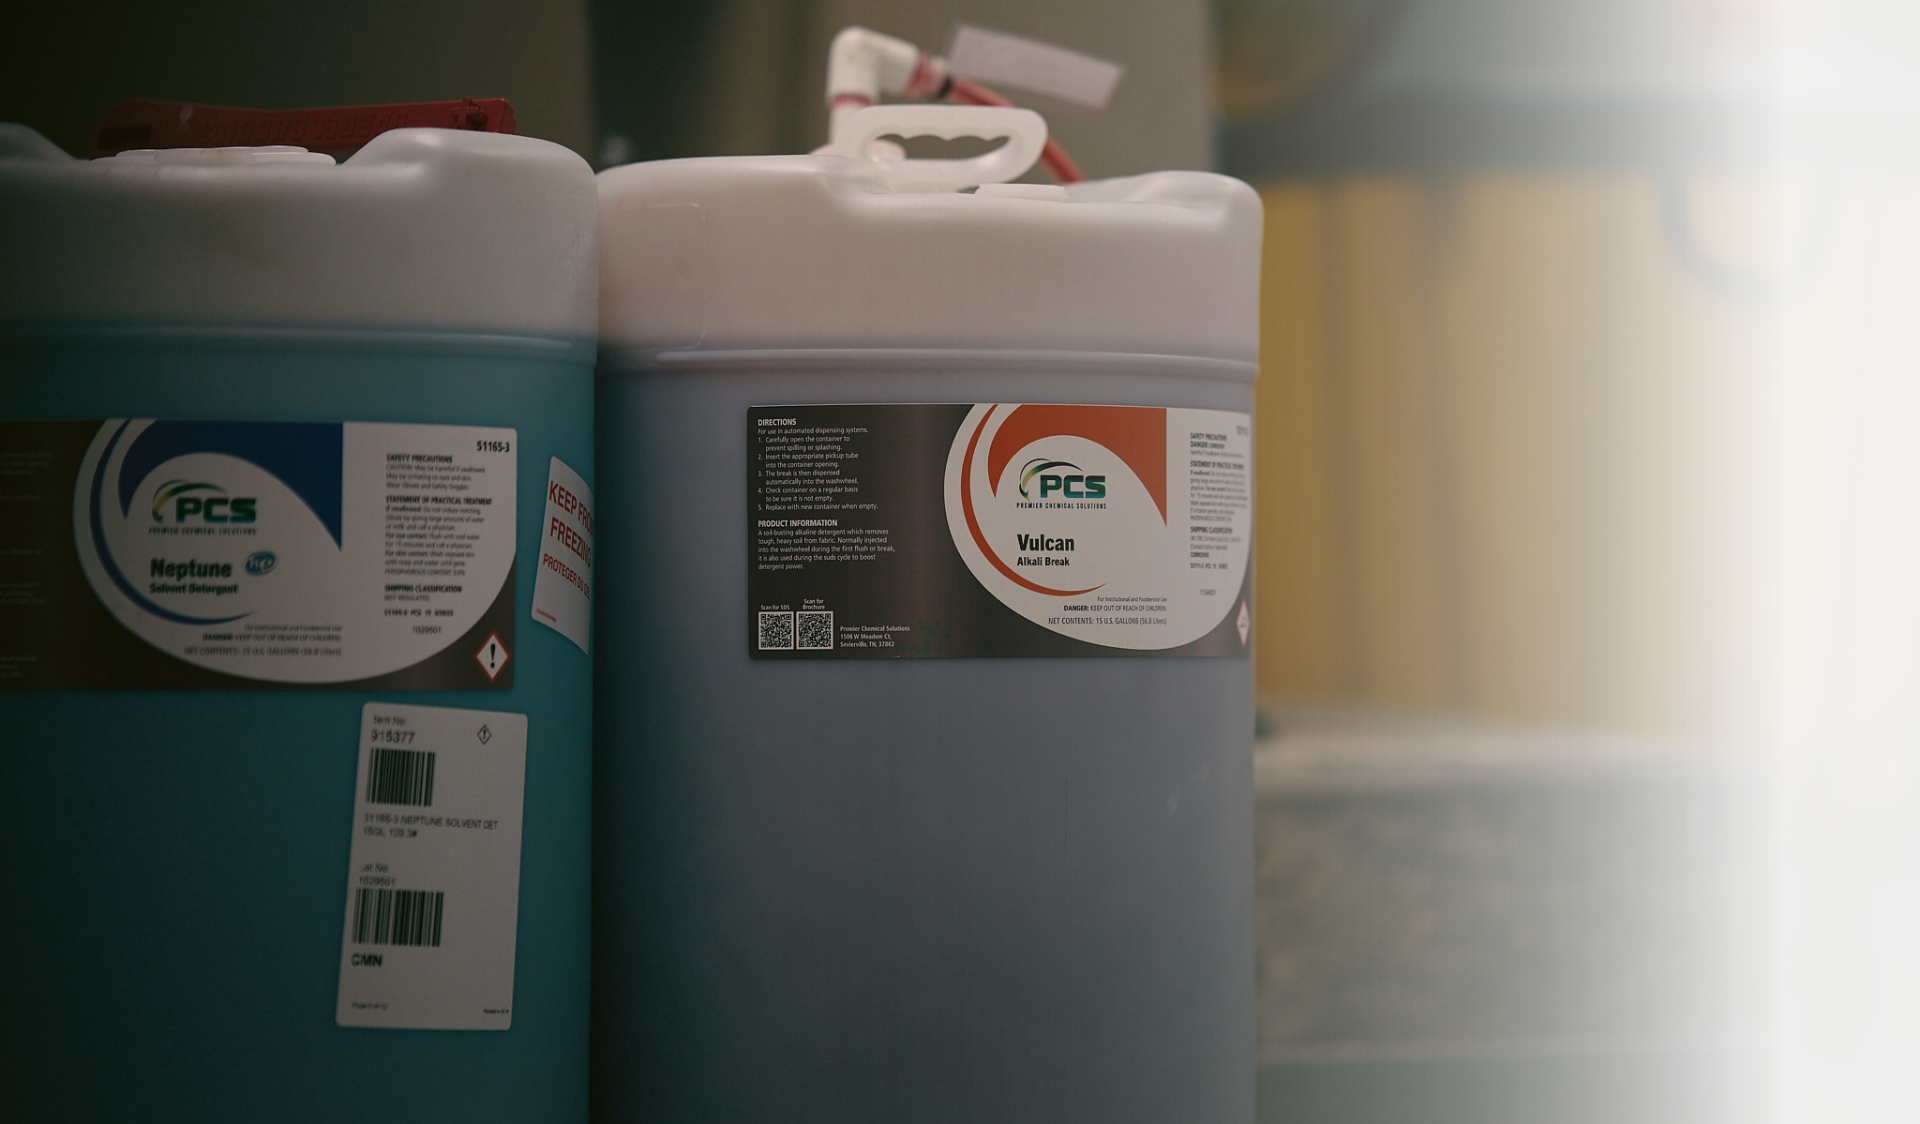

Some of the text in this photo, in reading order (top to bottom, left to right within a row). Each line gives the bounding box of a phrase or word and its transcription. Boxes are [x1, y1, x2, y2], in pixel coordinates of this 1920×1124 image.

[477, 441, 510, 452] 51165-3
[1040, 476, 1106, 498] PCS
[549, 481, 577, 515] KEEP
[176, 497, 256, 523] PCS
[550, 517, 592, 567] FREEZING
[1017, 534, 1074, 551] Vulcan
[150, 558, 232, 581] Neptune
[1017, 557, 1070, 566] Alkali Break
[543, 553, 577, 586] PROTEGER
[578, 578, 584, 592] DU
[150, 584, 238, 595] Solvent Detergent
[370, 730, 415, 743] 915377
[401, 816, 443, 826] NEPTUNE
[446, 818, 481, 828] SOLVENT
[483, 820, 497, 830] DET
